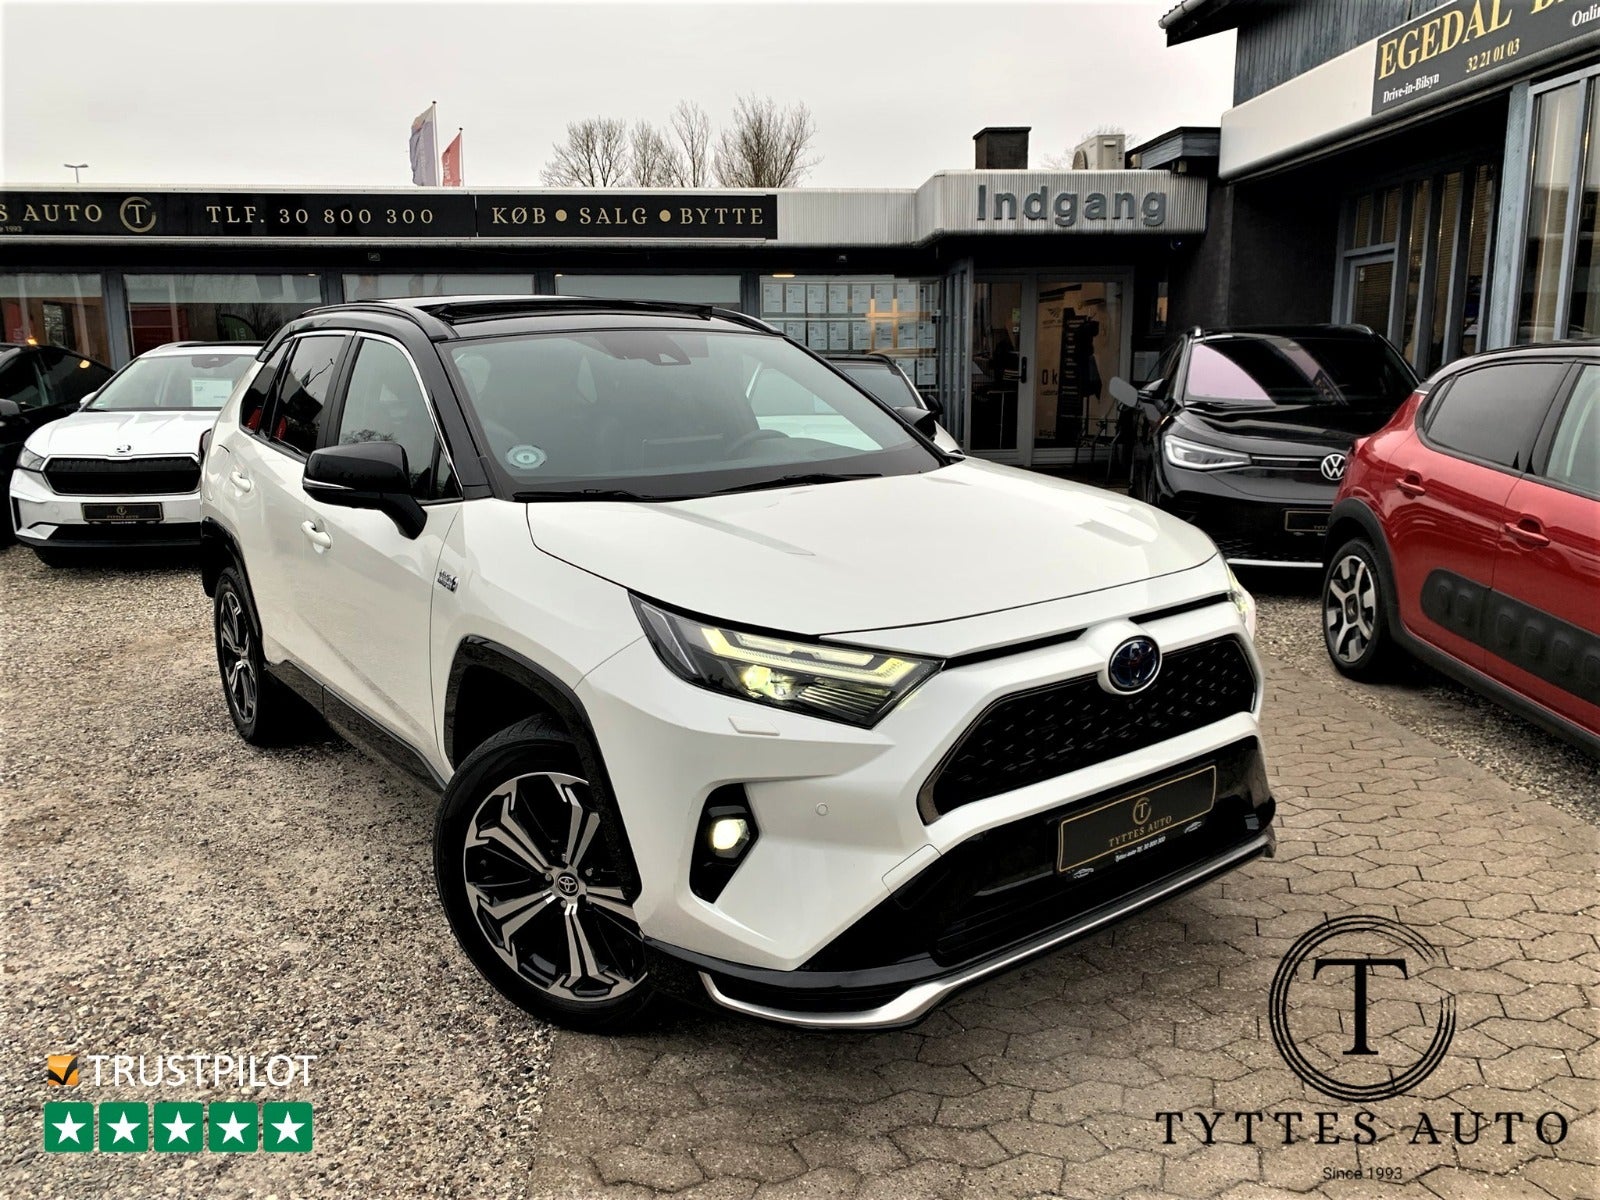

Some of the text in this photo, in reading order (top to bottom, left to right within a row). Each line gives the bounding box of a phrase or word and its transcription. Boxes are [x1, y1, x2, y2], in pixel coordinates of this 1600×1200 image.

[1378, 0, 1513, 80] EGEDAL
[1466, 38, 1520, 73] 32 21 01 03
[1382, 73, 1440, 104] Drive-in-Bilsyn
[23, 204, 102, 222] AUTO
[206, 206, 433, 224] TLF. 30 800 300
[491, 207, 764, 225] KØB SALG BYTTE
[977, 185, 1167, 227] Indgang
[1109, 815, 1172, 847] TYTTES AUTO
